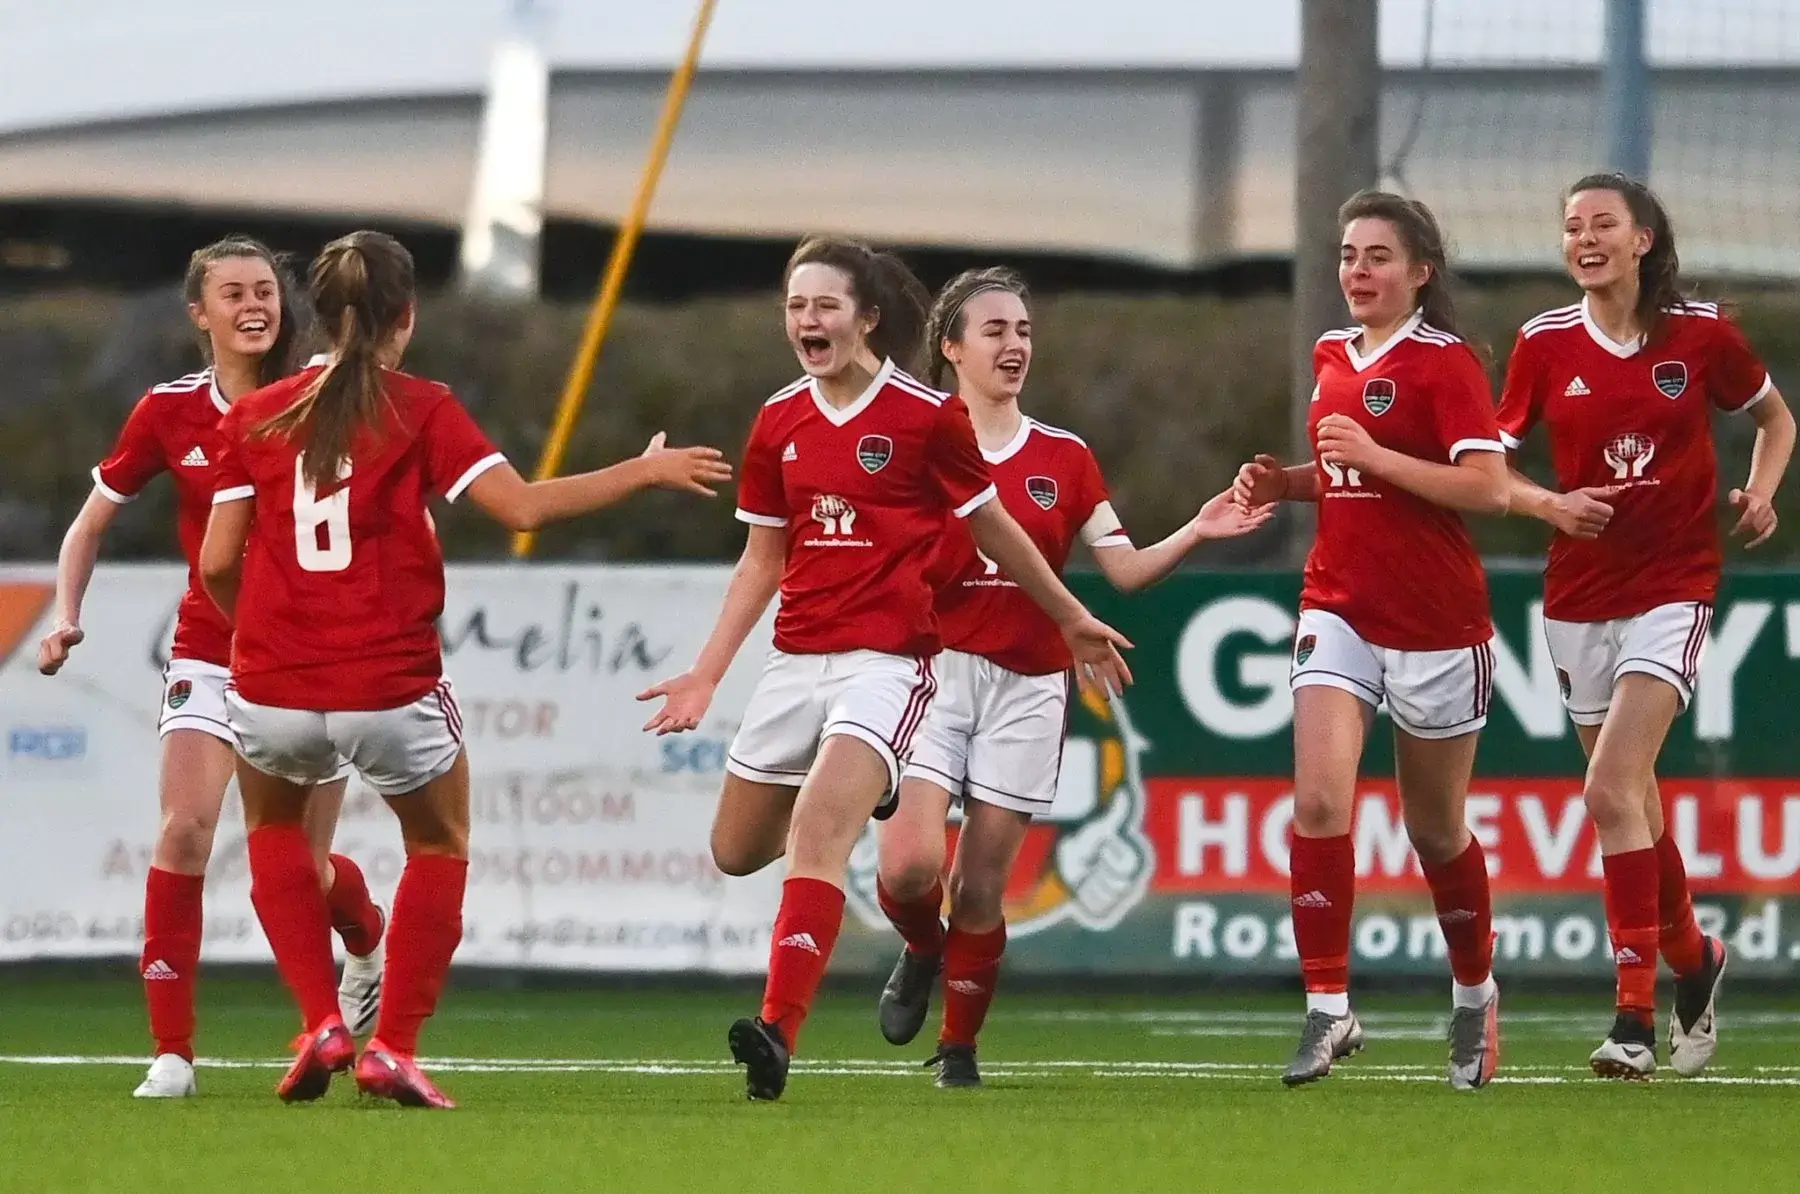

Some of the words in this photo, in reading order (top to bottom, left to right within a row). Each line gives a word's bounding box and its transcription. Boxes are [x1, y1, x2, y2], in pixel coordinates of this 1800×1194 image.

[292, 449, 354, 572] 6
[1176, 596, 1800, 742] GNY'
[1177, 792, 1800, 878] HMEVLU
